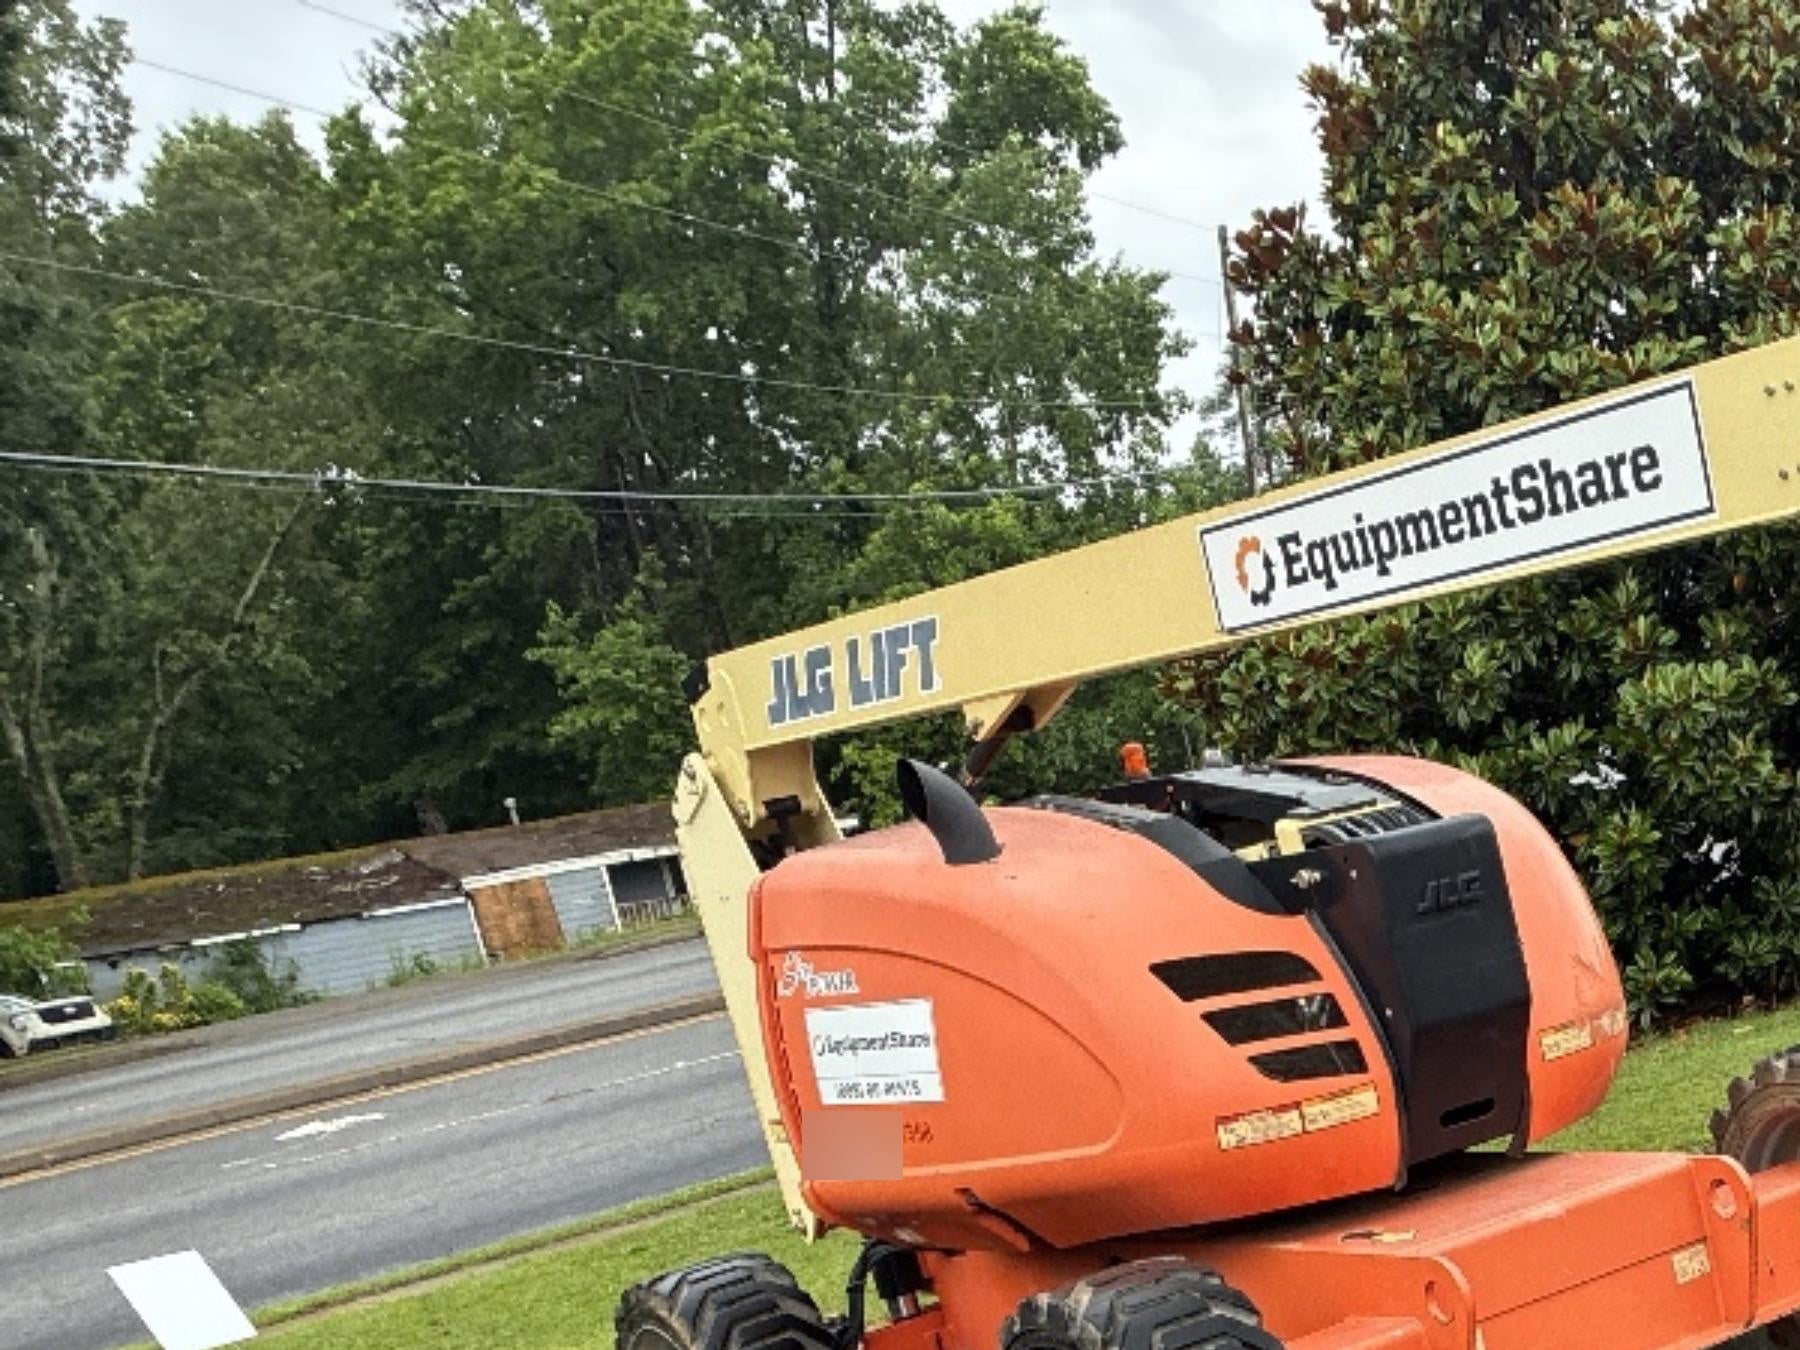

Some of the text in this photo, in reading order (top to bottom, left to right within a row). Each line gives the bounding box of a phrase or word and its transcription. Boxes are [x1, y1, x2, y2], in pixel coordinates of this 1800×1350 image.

[1277, 443, 1663, 591] EquipmentShare
[767, 615, 943, 729] JLG LIFT
